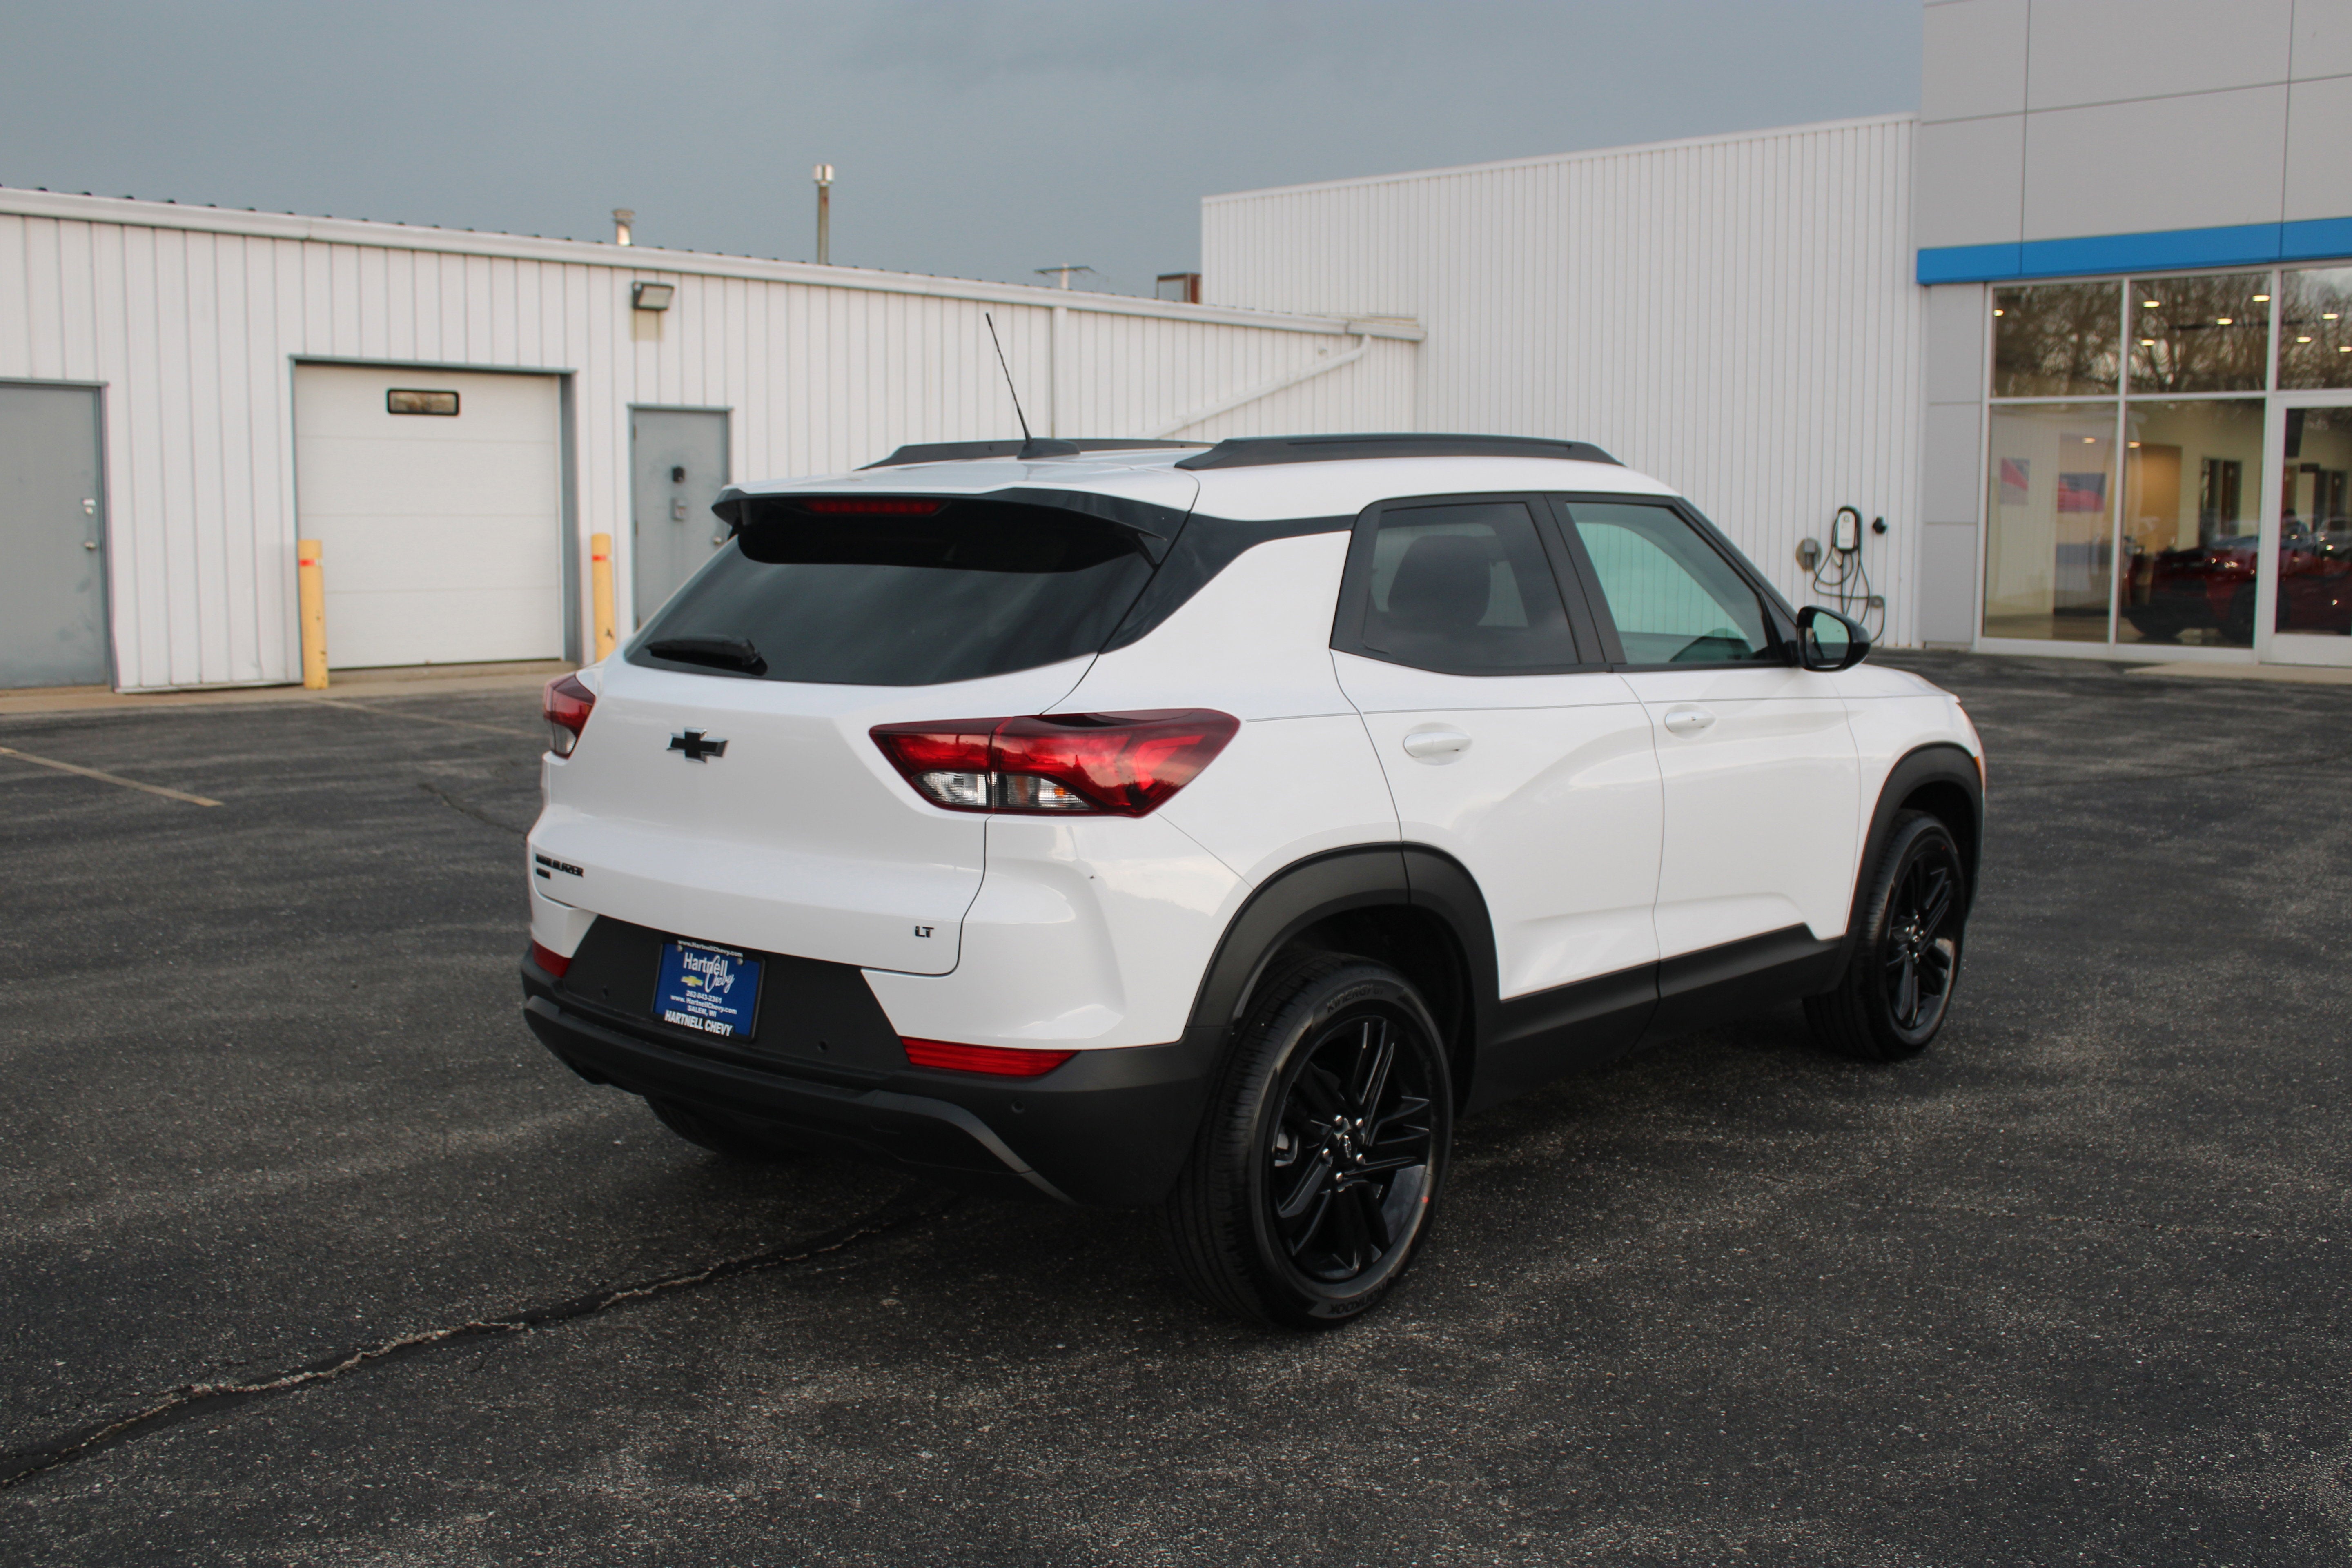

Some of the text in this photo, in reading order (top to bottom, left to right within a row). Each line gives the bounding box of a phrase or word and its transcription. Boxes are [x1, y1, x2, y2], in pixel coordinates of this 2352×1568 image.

[915, 926, 934, 938] LT
[678, 940, 743, 957] www.HartnellChevy.com
[683, 953, 728, 976] Hartnell
[705, 955, 735, 993] Chevy
[686, 998, 737, 1014] HartnellChevy.com
[687, 1005, 708, 1016] SALEM,
[665, 1010, 733, 1036] HARTNELL CHEVY
